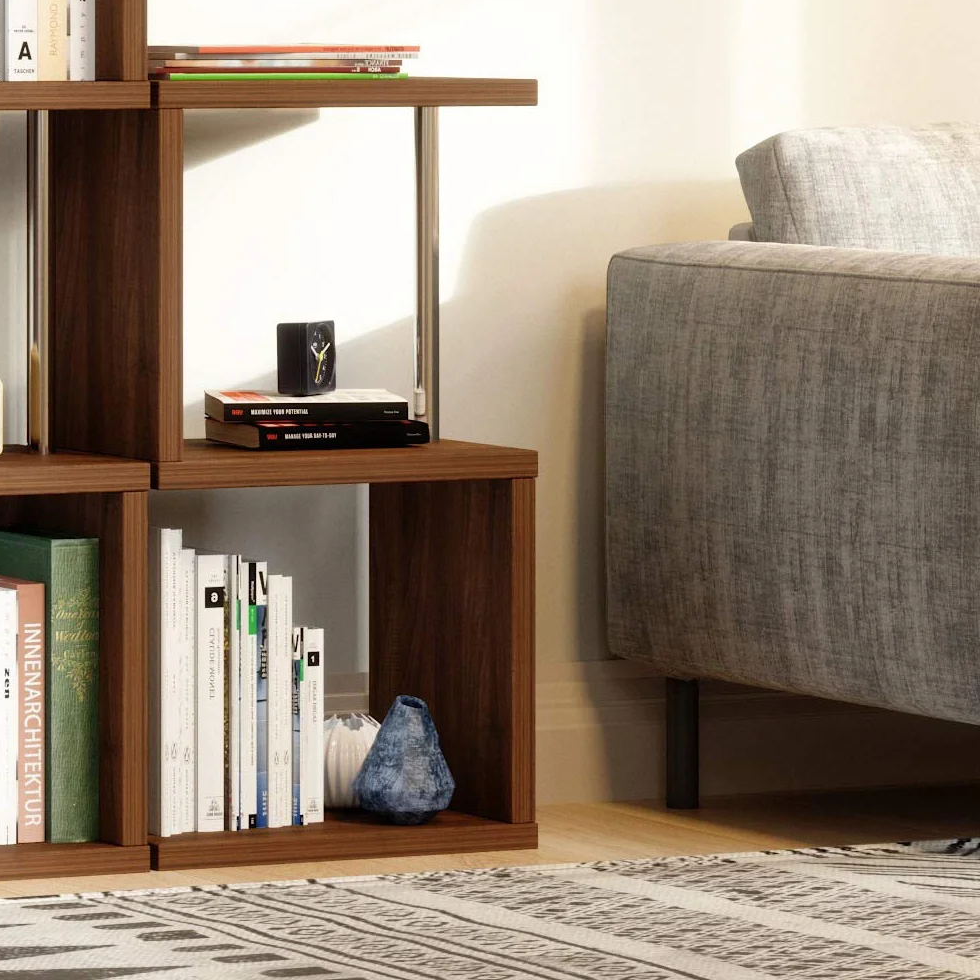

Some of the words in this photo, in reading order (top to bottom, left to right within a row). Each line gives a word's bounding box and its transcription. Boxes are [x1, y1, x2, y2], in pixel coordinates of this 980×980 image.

[18, 41, 32, 60] A
[49, 3, 58, 56] RAYMOND
[23, 622, 42, 827] INNENARCHITEKTUR
